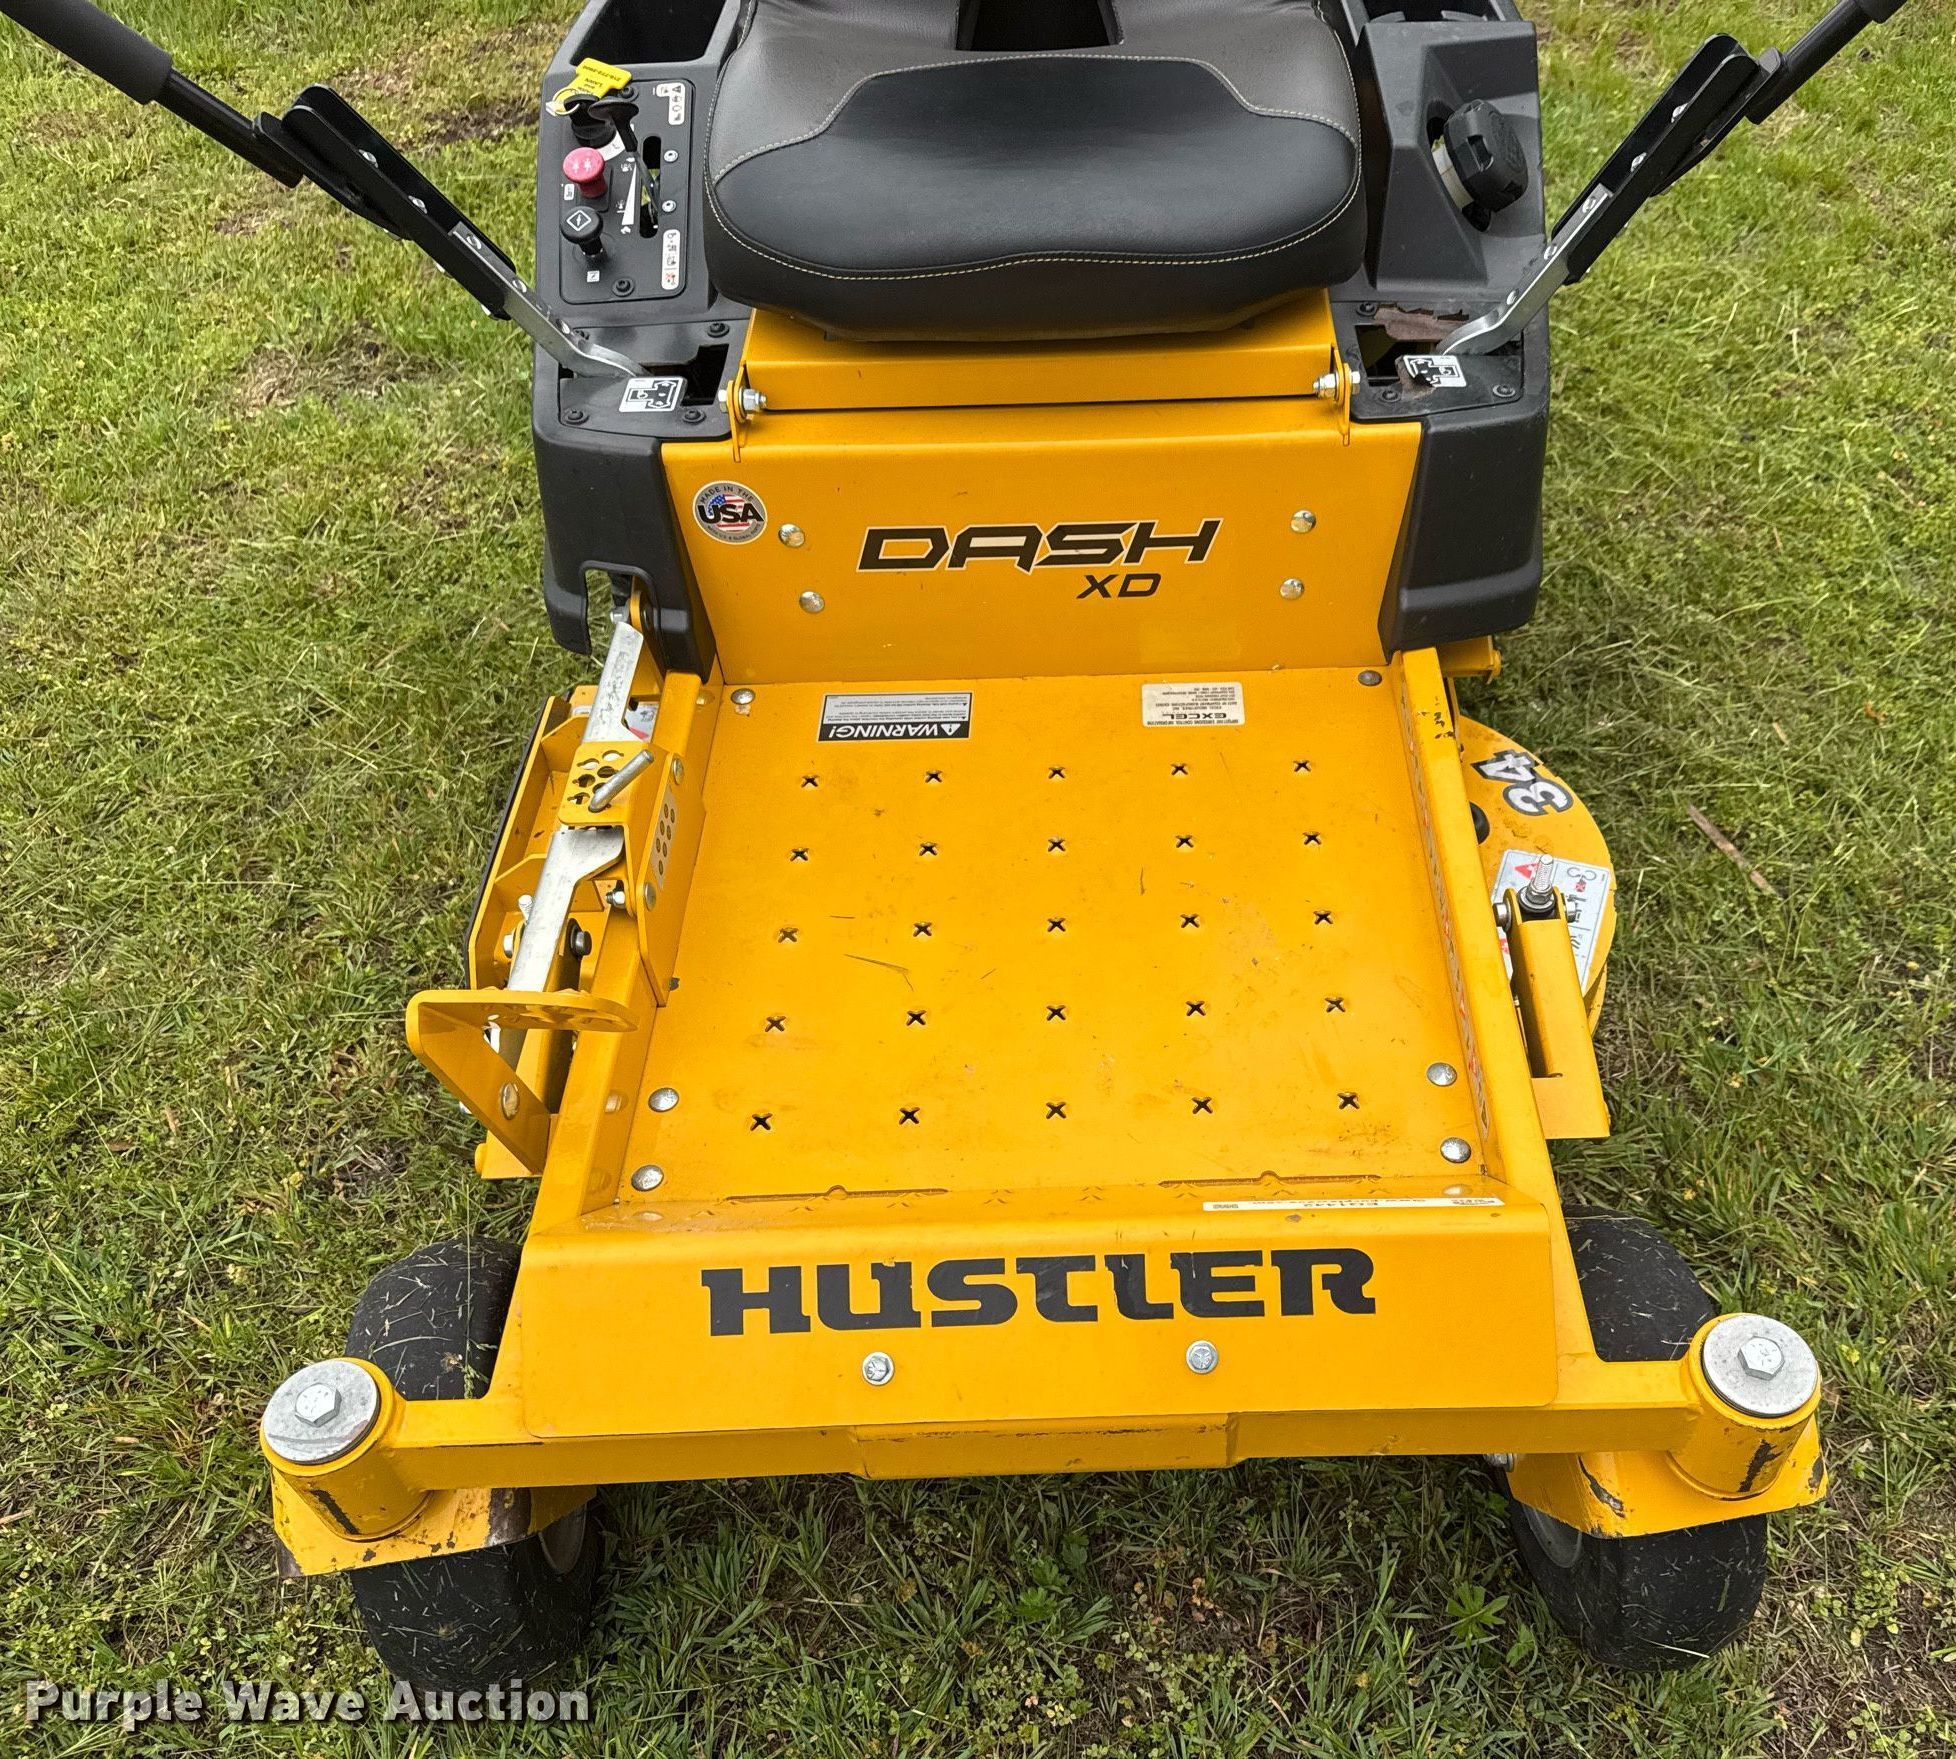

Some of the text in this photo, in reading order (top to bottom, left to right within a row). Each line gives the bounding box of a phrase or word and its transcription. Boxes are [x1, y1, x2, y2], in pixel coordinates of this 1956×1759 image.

[700, 485, 754, 504] MADE IN THE
[697, 502, 765, 524] USA
[856, 518, 1224, 575] DASH
[1075, 573, 1161, 599] XD
[1162, 712, 1227, 720] EXCEL
[828, 723, 939, 738] WARNING!
[1471, 749, 1574, 816] 34
[701, 1248, 1376, 1336] HUSTLER
